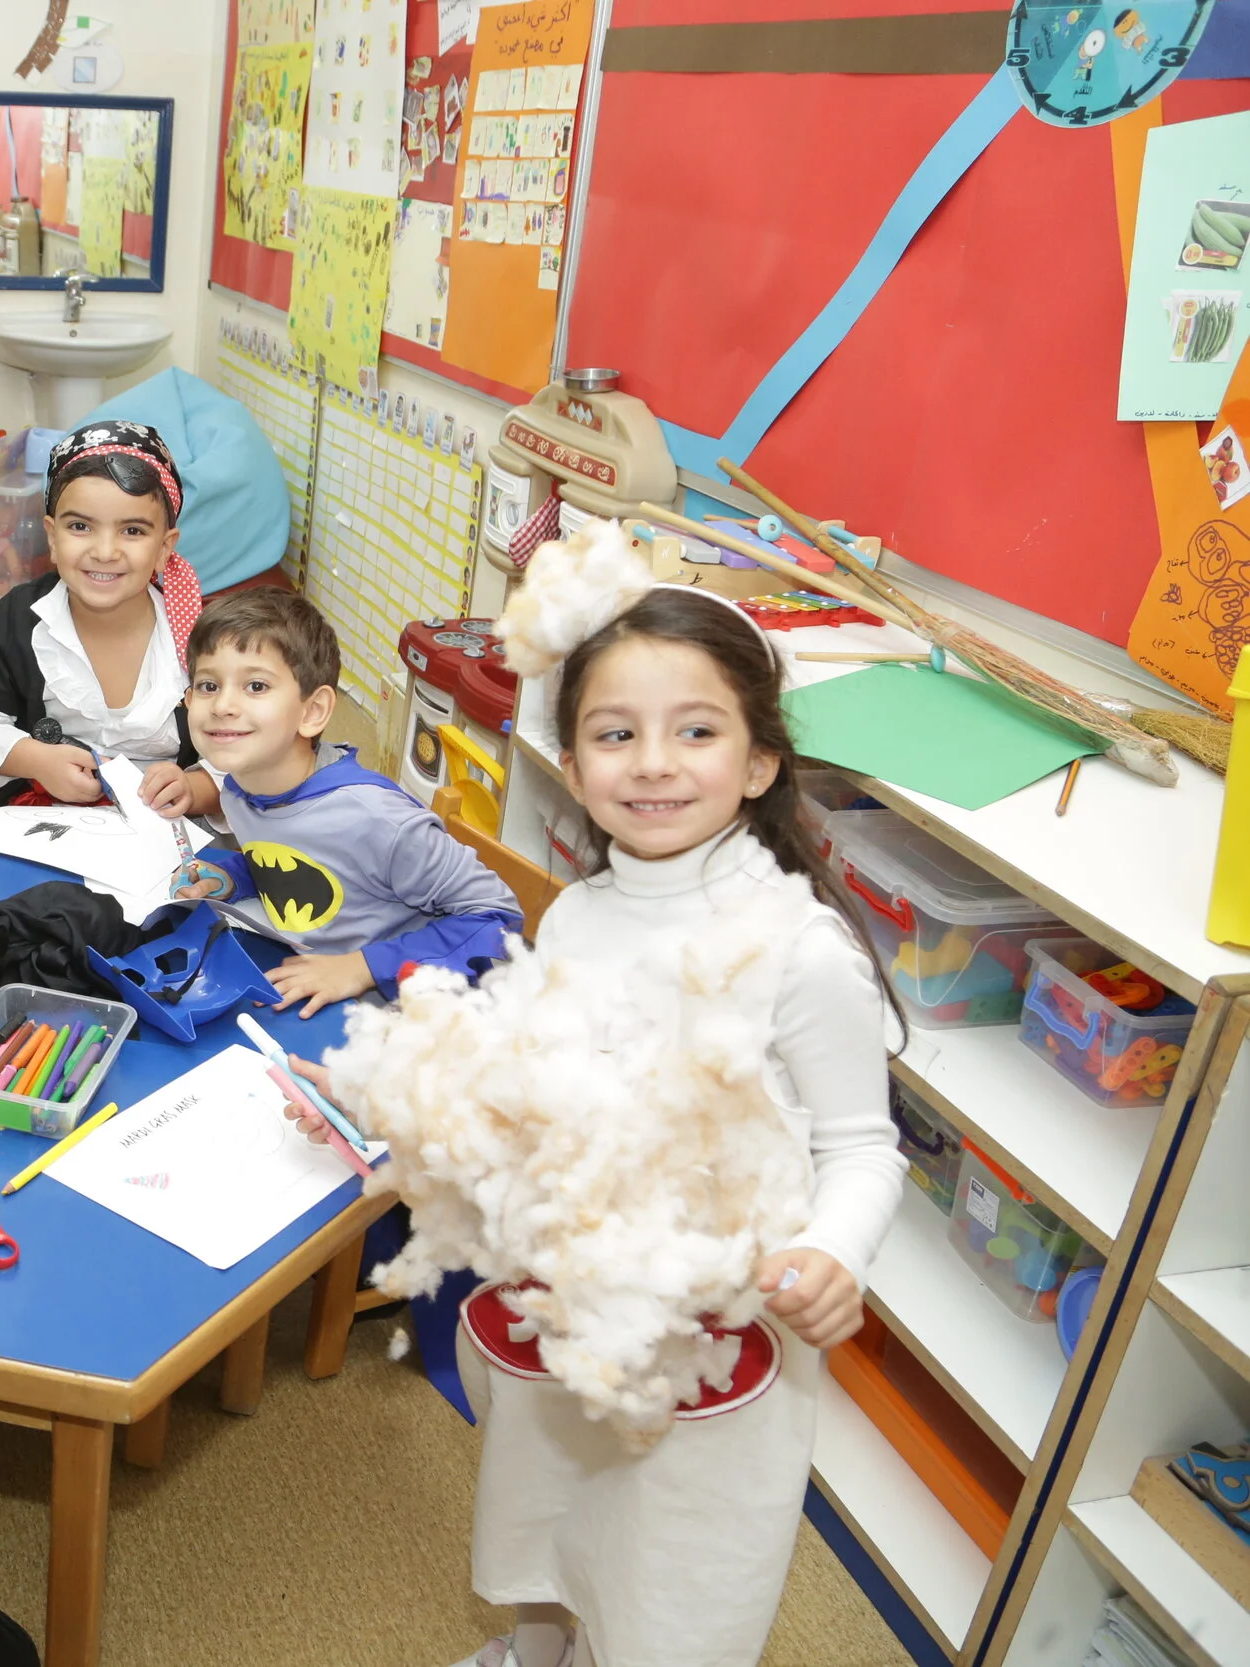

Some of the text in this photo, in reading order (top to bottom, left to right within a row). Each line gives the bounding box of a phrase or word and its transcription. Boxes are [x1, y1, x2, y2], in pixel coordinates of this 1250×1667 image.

[1006, 48, 1031, 67] 5
[1158, 46, 1191, 67] 3
[1062, 106, 1092, 125] 4
[119, 1094, 200, 1148] MARDI GRAS MASK
